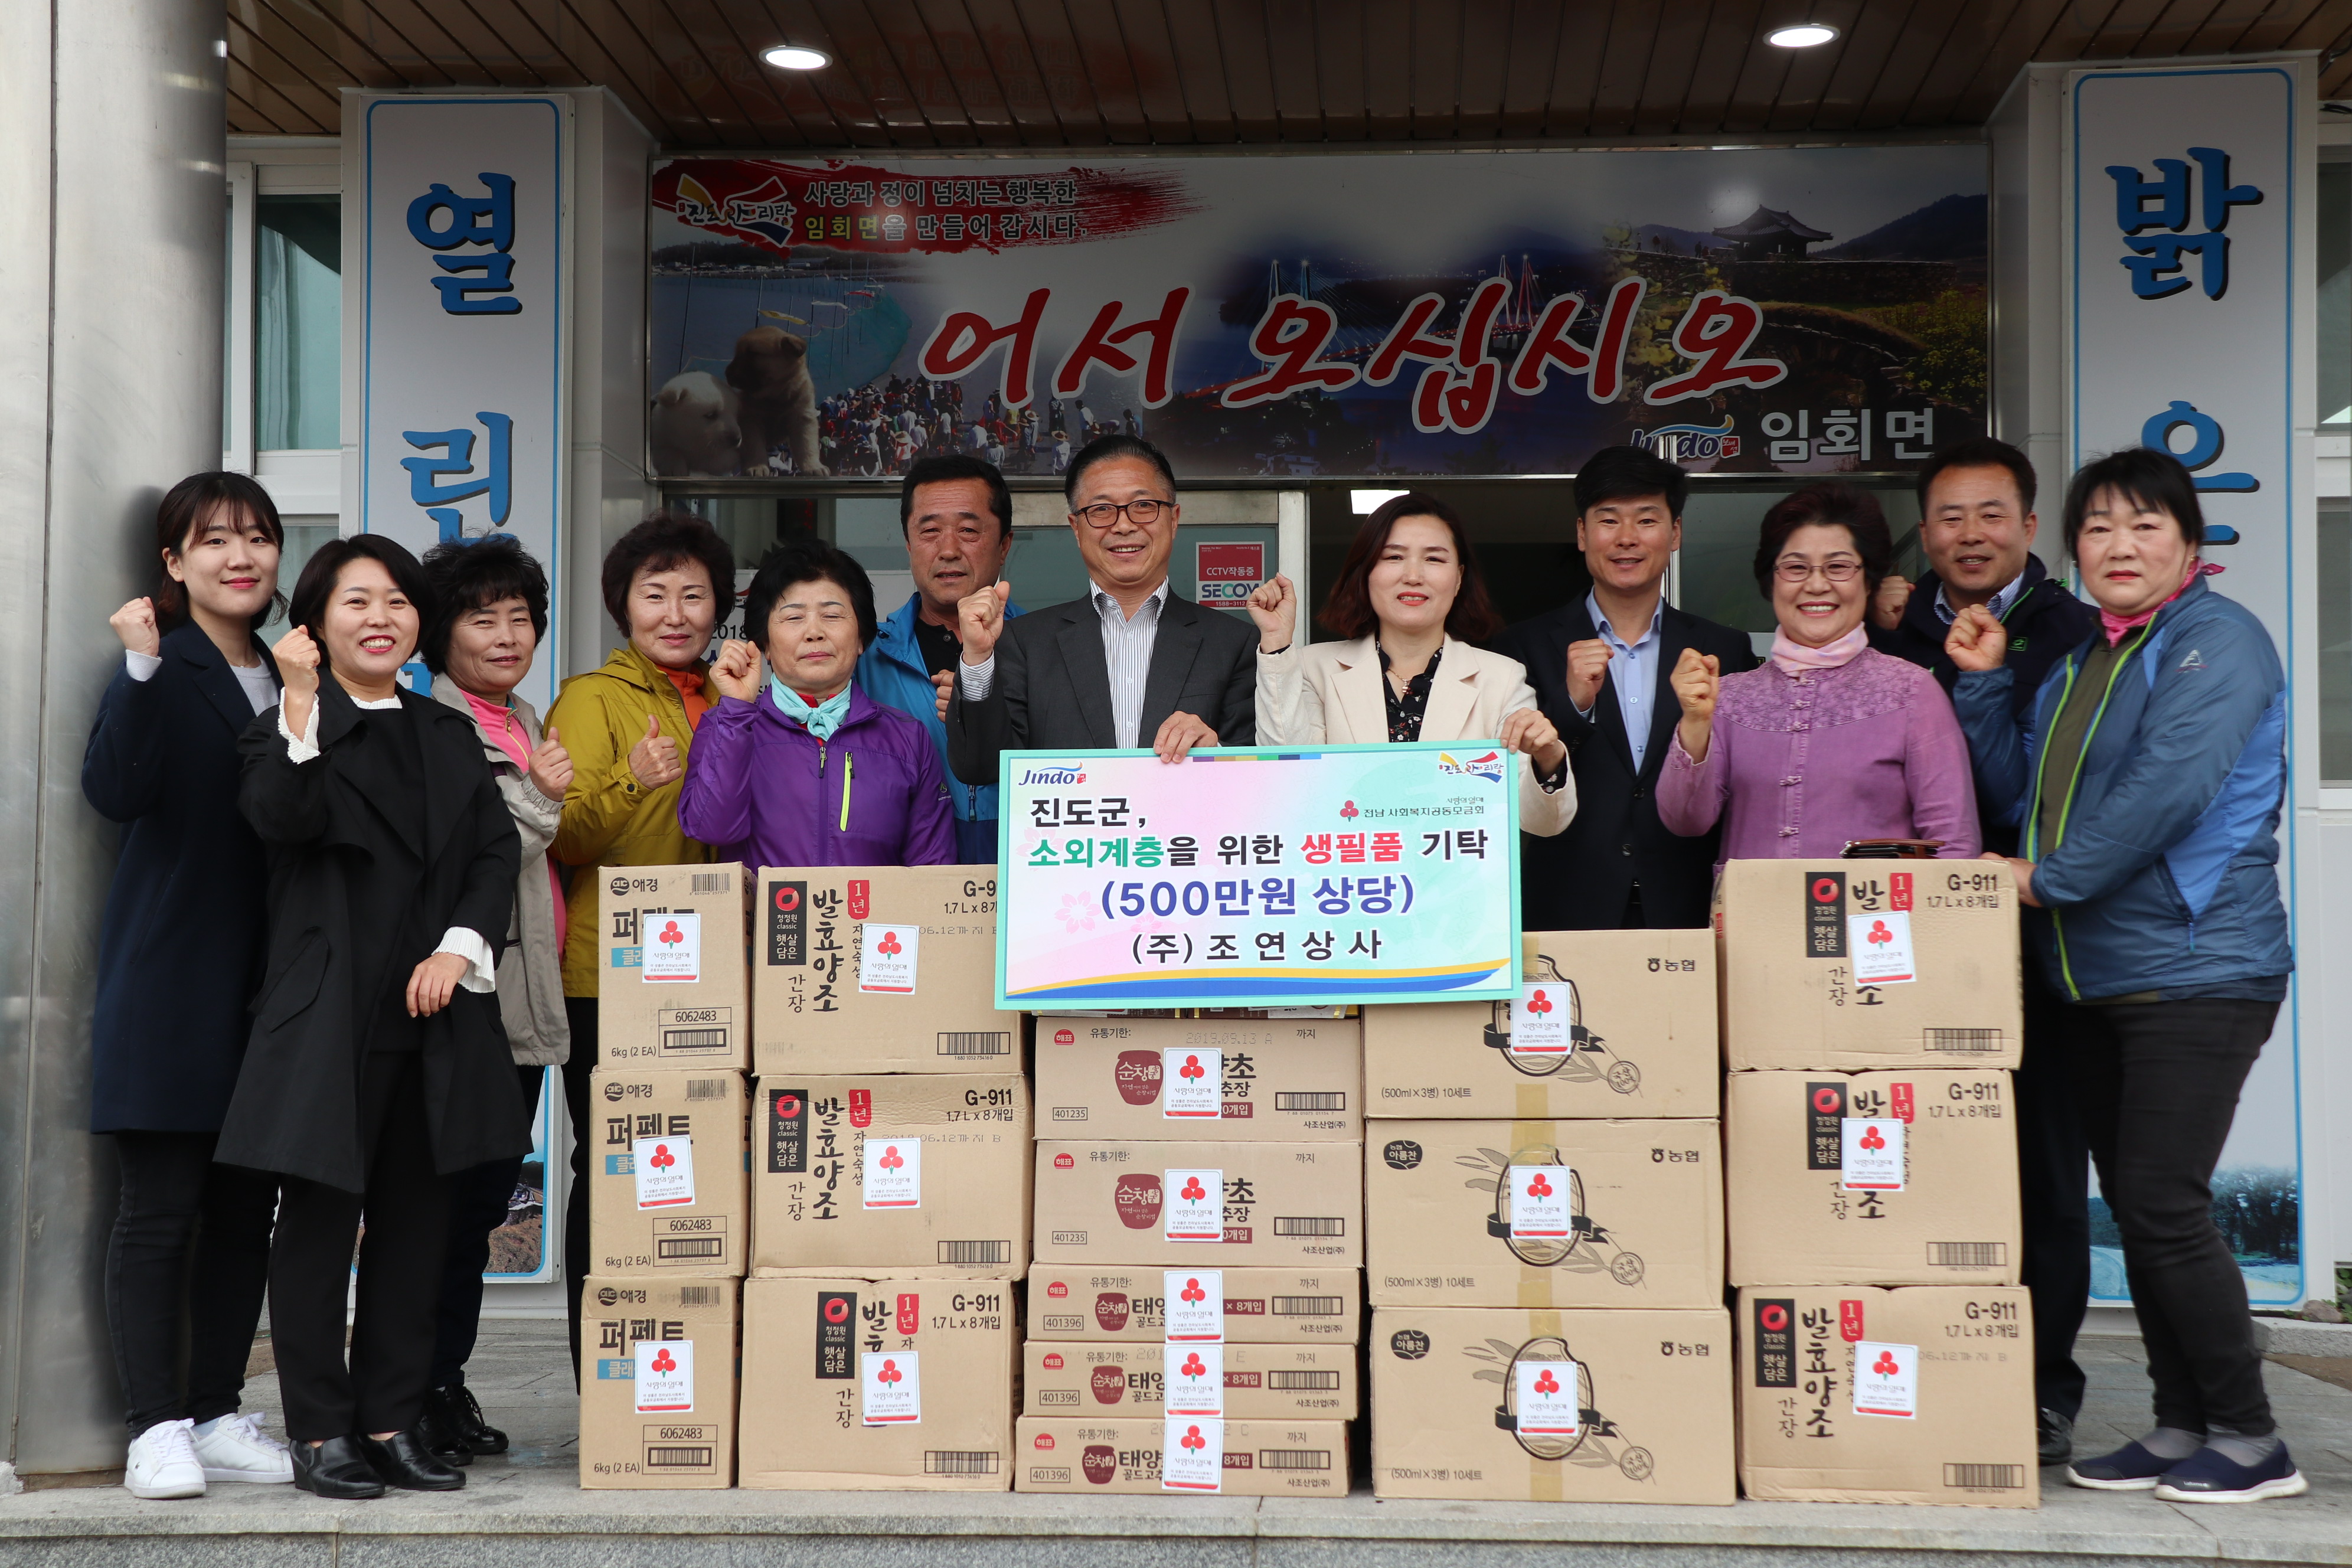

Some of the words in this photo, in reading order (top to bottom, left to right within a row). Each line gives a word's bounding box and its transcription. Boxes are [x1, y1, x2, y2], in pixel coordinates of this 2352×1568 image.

[805, 181, 874, 206] 사랑과
[881, 179, 925, 206] 정이
[932, 179, 1002, 206] 넘치는
[1008, 178, 1076, 206] 행복한
[805, 214, 907, 240] 임회면을
[916, 214, 992, 240] 만들어
[999, 213, 1086, 240] 갑시다.
[922, 284, 1193, 407] 어서
[1225, 280, 1785, 432] 오십시오
[1762, 408, 1935, 460] 임회면
[1207, 567, 1254, 576] CCTV작동중
[1018, 770, 1075, 785] Jindo
[1031, 796, 1146, 829] 진도군,
[1364, 809, 1384, 817] 전남
[1388, 806, 1484, 816] 사회복지공동모금회
[1028, 837, 1199, 868] 소외계층을
[1218, 835, 1283, 865] 위한
[1301, 832, 1403, 863] 생필품
[1422, 829, 1488, 860] 기탁
[632, 878, 658, 892] 애경
[1948, 874, 1998, 891] G-911
[1101, 880, 1295, 919] (500만원
[1312, 874, 1414, 915] 상당)
[1927, 896, 1941, 909] 1.7
[1966, 895, 1999, 909] 8개입
[945, 903, 959, 914] 1.7
[777, 914, 798, 922] 청정원
[776, 933, 798, 946] 햇살
[776, 947, 798, 959] 담은
[813, 889, 844, 1012] 발효양조
[1664, 959, 1696, 972] 농협
[1828, 966, 1848, 1007] 간장
[788, 974, 806, 1013] 간장
[675, 1011, 717, 1023] 6062483
[1090, 1027, 1132, 1038] 유통기한:
[1296, 1028, 1316, 1040] 까지
[612, 1047, 628, 1058] 6kg
[627, 1084, 652, 1098] 애경
[965, 1089, 1012, 1106] G-911
[1443, 1087, 1472, 1098] 10세트
[1949, 1083, 2000, 1100] G-911
[946, 1111, 959, 1122] 1.7
[984, 1109, 1013, 1121] 8개입
[1054, 1109, 1086, 1119] 401235
[1929, 1106, 1943, 1119] 1.7
[1969, 1105, 2001, 1118] 8개입
[778, 1121, 798, 1130] 청정원
[1304, 1121, 1346, 1129] 사조산업(주)
[776, 1141, 798, 1153] 햇살
[776, 1154, 798, 1167] 담은
[812, 1097, 845, 1219] 발효양조
[852, 1131, 867, 1186] 자연숙성
[1089, 1151, 1130, 1162] 유통기한:
[1295, 1153, 1315, 1164] 까지
[1389, 1149, 1417, 1161] 아름찬
[1668, 1149, 1699, 1163] 농협
[1056, 1158, 1073, 1166] 해표
[788, 1181, 805, 1221] 간장
[670, 1220, 711, 1231] 6062483
[1054, 1233, 1085, 1243] 401235
[1302, 1246, 1345, 1255] 사조산업(주)
[606, 1257, 622, 1267] 6kg
[1090, 1276, 1132, 1288] 유통기한:
[1299, 1278, 1319, 1289] 까지
[1446, 1277, 1475, 1288] 10세트
[620, 1289, 646, 1304] 애경
[1050, 1286, 1066, 1295] 해표
[952, 1295, 1000, 1312] G-911
[1236, 1301, 1262, 1312] 8개입
[1965, 1302, 2017, 1319] G-911
[932, 1317, 944, 1329] 1.7
[969, 1316, 1001, 1329] 8개입
[1046, 1318, 1082, 1329] 401396
[1299, 1324, 1342, 1333] 사조산업(주)
[826, 1326, 846, 1335] 청정원
[1945, 1325, 1959, 1338] 1.7
[1985, 1324, 2019, 1338] 8개입
[1396, 1339, 1425, 1351] 아름찬
[1678, 1342, 1710, 1357] 농협
[824, 1346, 846, 1360] 햇살
[1086, 1351, 1128, 1363] 유통기한:
[1295, 1352, 1315, 1364] 까지
[825, 1360, 846, 1373] 담은
[1045, 1358, 1062, 1367] 해표
[1802, 1307, 1837, 1438] 발효양조
[1233, 1374, 1258, 1385] 8개입
[1042, 1392, 1077, 1403] 401396
[1296, 1399, 1340, 1407] 사조산업(주)
[836, 1389, 854, 1428] 간장
[1778, 1397, 1798, 1438] 간장
[660, 1427, 702, 1439] 6062483
[1077, 1429, 1119, 1440] 유통기한:
[1286, 1431, 1306, 1443] 까지
[1036, 1438, 1053, 1446] 해표
[1224, 1455, 1249, 1466] 8개입
[594, 1463, 610, 1474] 6kg
[1453, 1469, 1482, 1481] 10세트
[1033, 1471, 1068, 1481] 401396
[1287, 1478, 1330, 1488] 사조산업(주)
